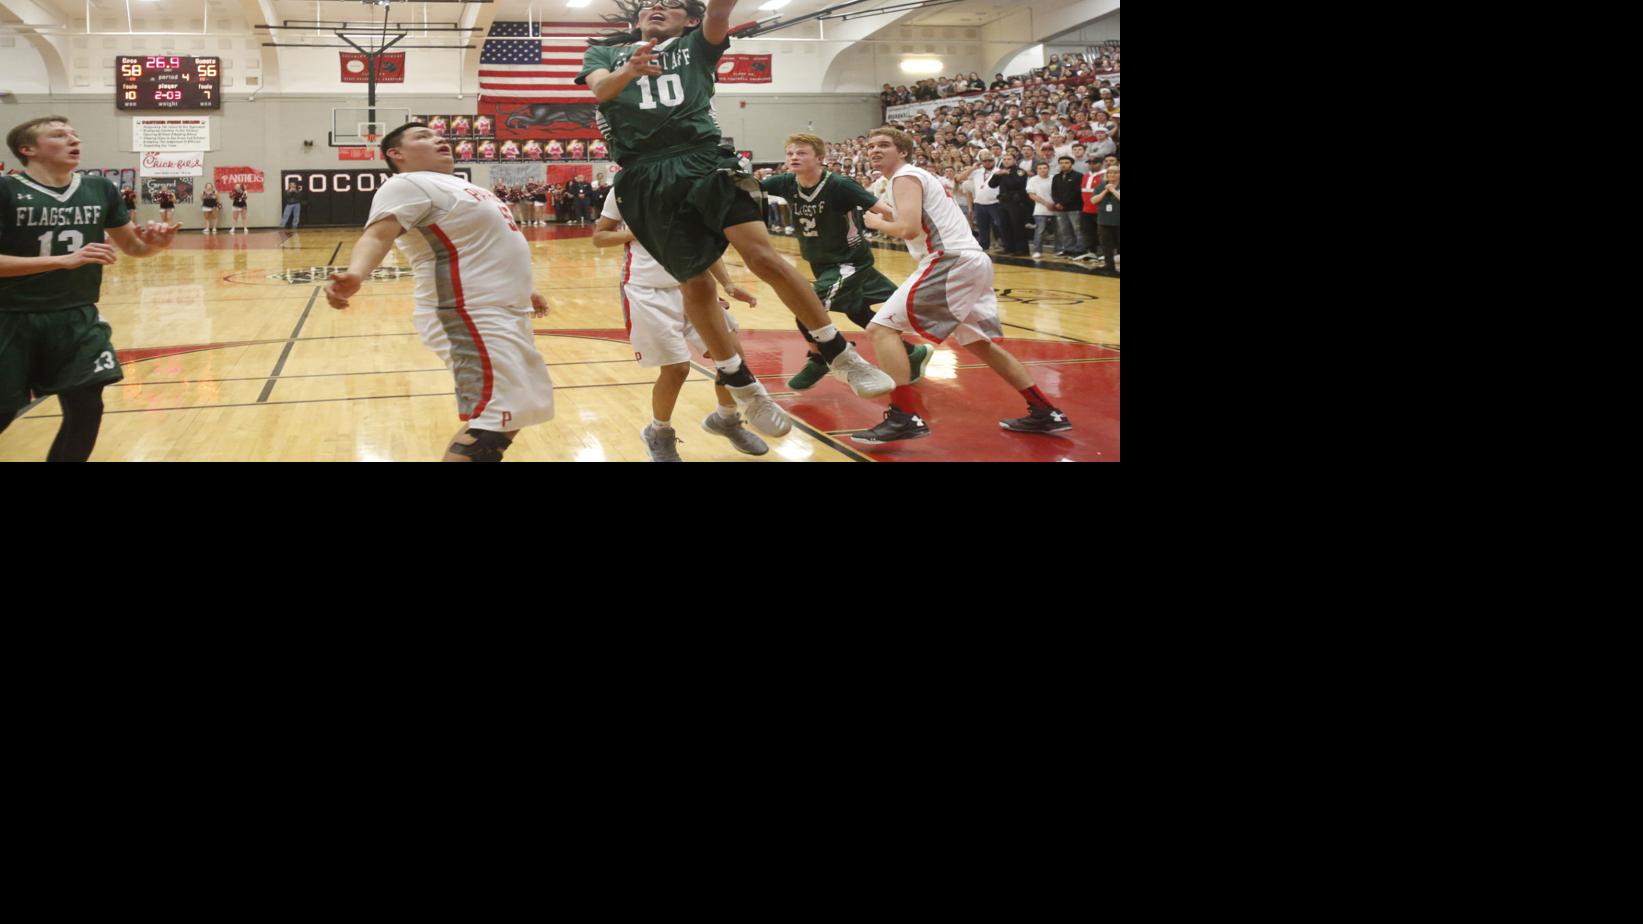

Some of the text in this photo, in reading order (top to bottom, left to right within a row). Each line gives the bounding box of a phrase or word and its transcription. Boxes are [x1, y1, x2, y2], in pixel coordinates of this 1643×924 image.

[146, 56, 180, 69] 26.9
[122, 65, 142, 77] 58
[182, 73, 190, 81] 4
[197, 65, 217, 77] 56
[125, 91, 137, 100] 10
[203, 91, 211, 100] 7
[637, 73, 684, 110] 10
[221, 173, 264, 184] PANTHERS
[38, 230, 84, 257] 13
[94, 350, 115, 373] 13
[502, 411, 512, 427] P
